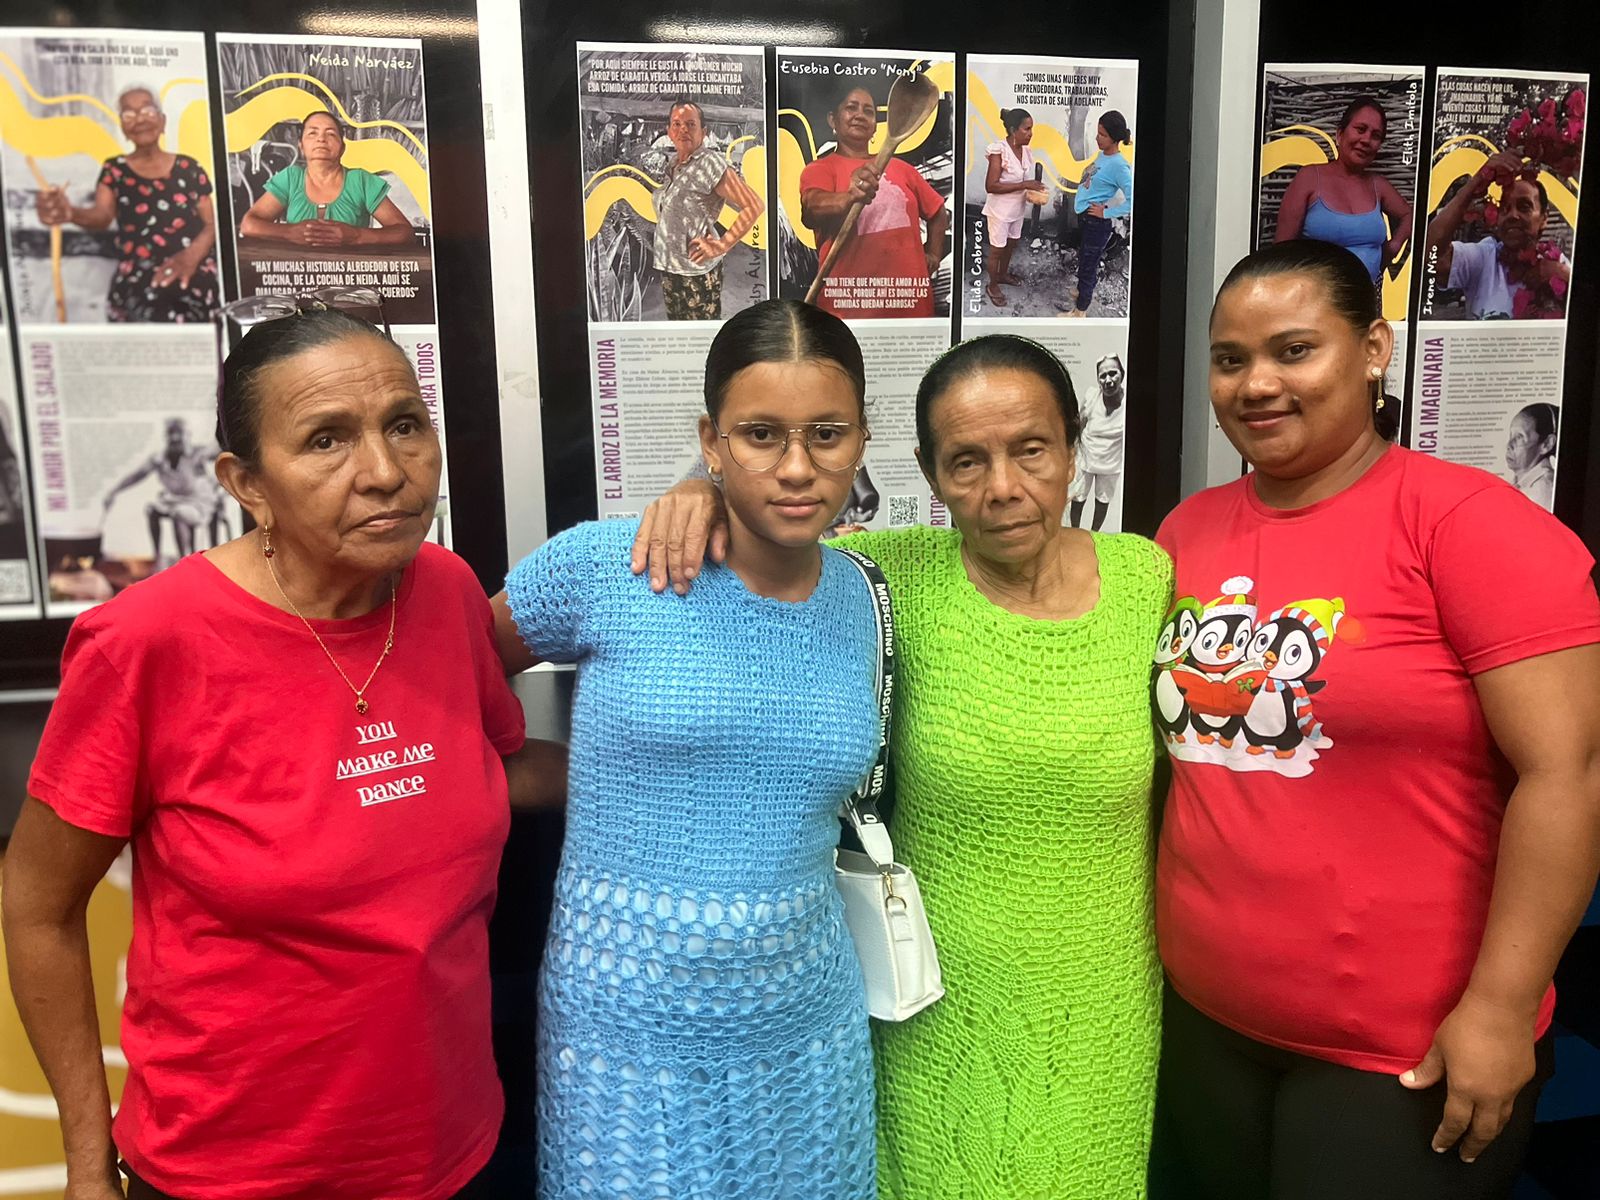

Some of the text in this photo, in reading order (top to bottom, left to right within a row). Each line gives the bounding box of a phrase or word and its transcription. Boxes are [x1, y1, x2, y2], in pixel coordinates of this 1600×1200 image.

[310, 53, 414, 70] Neida Narváez
[621, 60, 648, 70] SIEMPRE
[650, 60, 657, 70] LE
[658, 60, 678, 70] GUSTA
[680, 61, 684, 70] A
[721, 62, 742, 72] MUCHO
[780, 60, 830, 74] Eusebia
[834, 62, 877, 76] Castro
[590, 71, 610, 80] ARROZ
[611, 72, 620, 81] DE
[620, 72, 650, 82] CARAOTA
[672, 72, 678, 81] A
[698, 73, 705, 82] LE
[706, 73, 742, 83] ENCANTABA
[1046, 74, 1062, 83] UNAS
[1063, 75, 1087, 84] MUJERES
[1088, 76, 1101, 85] MUY
[628, 84, 648, 93] ARROZ
[650, 84, 658, 93] DE
[659, 84, 688, 94] CARAOTA
[689, 84, 701, 94] CON
[702, 84, 722, 94] CARNE
[1014, 84, 1108, 96] EMPRENDEDORAS, TRABAJADORAS,
[1456, 82, 1472, 92] COSAS
[1492, 84, 1503, 92] POR
[1504, 84, 1514, 93] LOS
[1016, 95, 1028, 104] NOS
[1030, 96, 1048, 105] GUSTA
[1048, 96, 1056, 106] DE
[1057, 97, 1072, 106] SALIR
[1465, 104, 1482, 112] COSAS
[1482, 104, 1486, 113] Y
[1502, 105, 1510, 114] ME
[1402, 82, 1417, 166] Elith Imitola
[1459, 114, 1470, 123] RICO
[745, 224, 760, 278] Álvarez
[272, 262, 304, 272] MUCHAS
[306, 262, 345, 272] HISTORIAS
[346, 262, 388, 272] ALREDEDOR
[390, 262, 400, 272] DE
[401, 262, 420, 272] ESTA
[970, 220, 982, 314] Elida Cabrera
[262, 272, 410, 286] COCINA, DE LA COCINA DE NEIDA. AQUÍ SE
[839, 278, 855, 286] TIENE
[856, 278, 868, 286] QUE
[869, 278, 894, 286] PONERLE
[896, 278, 912, 286] AMOR
[913, 278, 918, 286] A
[918, 278, 930, 286] LAS
[1422, 244, 1438, 314] Irene Niño
[824, 288, 852, 298] COMIDAS,
[854, 288, 876, 298] PORQUE
[888, 288, 896, 298] ES
[896, 288, 916, 298] DONDE
[917, 288, 928, 298] LAS
[834, 300, 860, 308] COMIDAS
[861, 300, 884, 308] QUEDAN
[416, 343, 435, 380] TODOS
[32, 342, 57, 396] SALADO
[1420, 337, 1444, 426] IMAGINARIA
[37, 401, 60, 417] EL
[597, 338, 622, 500] EL ARROZ DE LA MEMORIA
[875, 583, 894, 657] MOSCHINO
